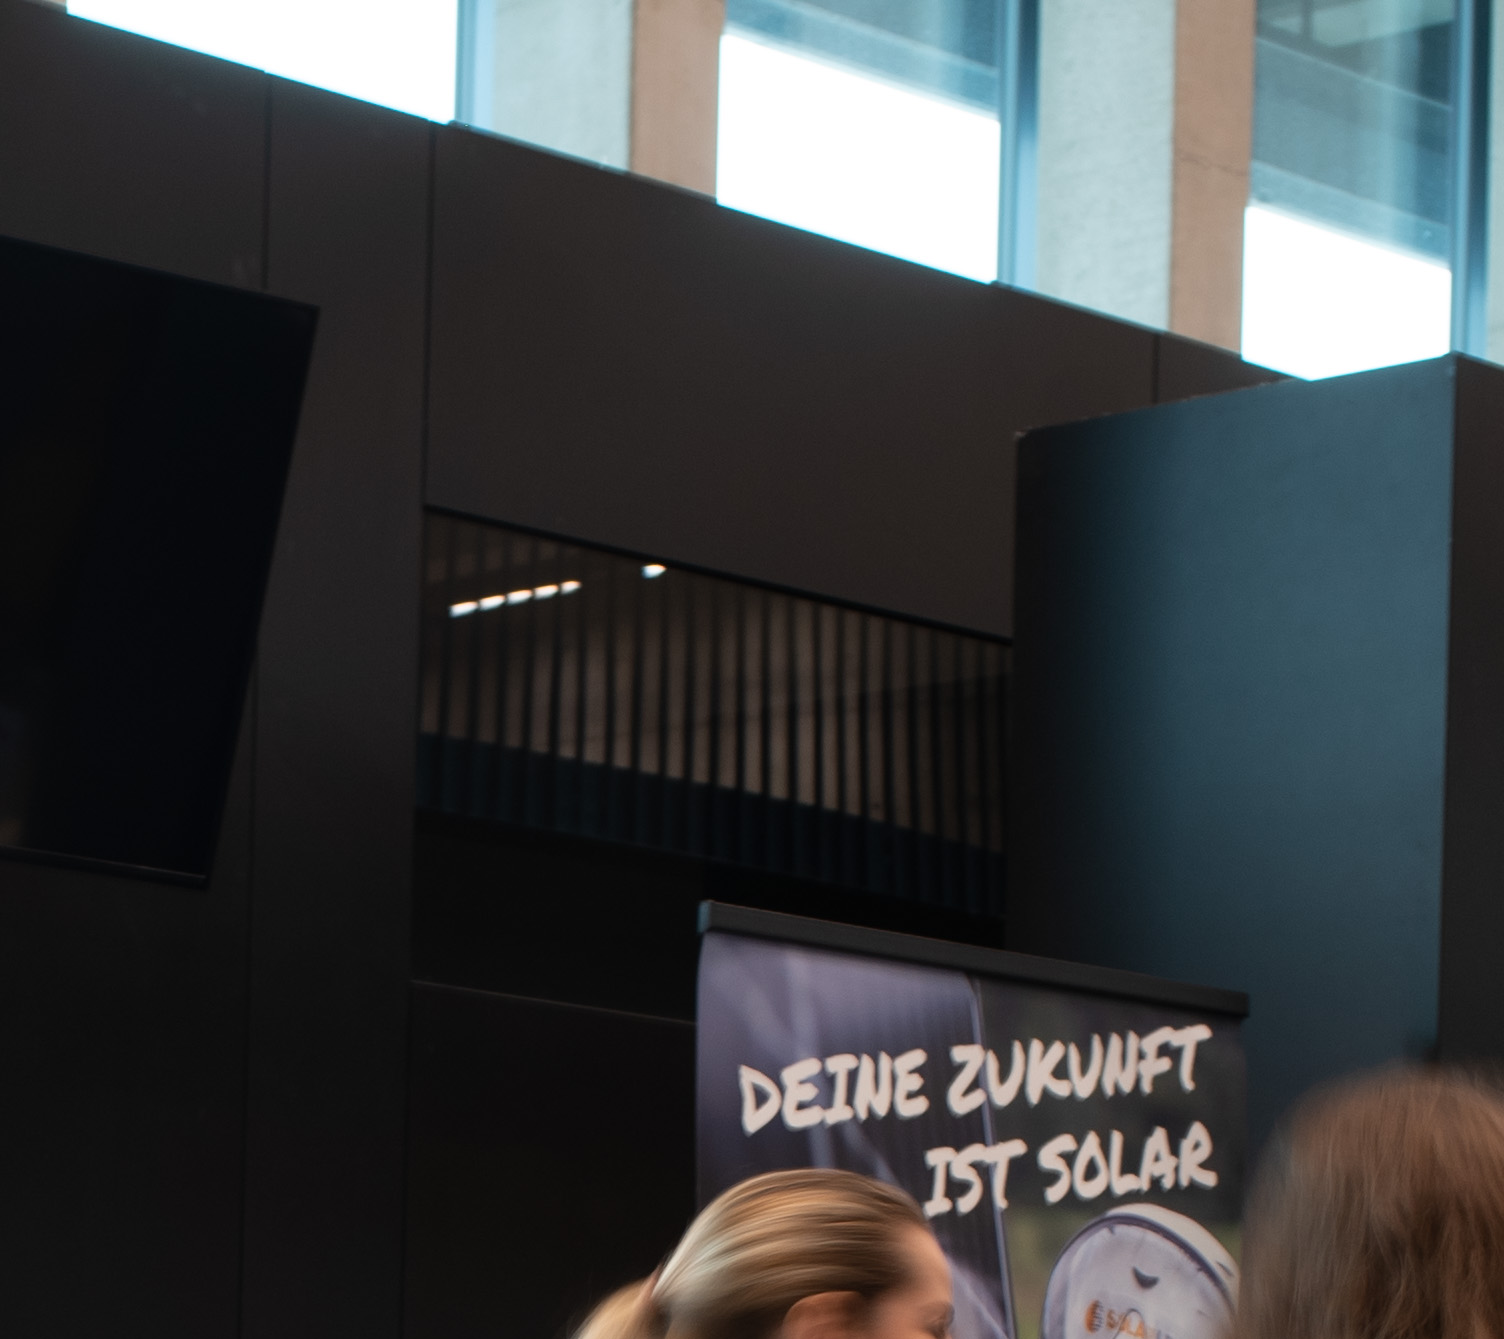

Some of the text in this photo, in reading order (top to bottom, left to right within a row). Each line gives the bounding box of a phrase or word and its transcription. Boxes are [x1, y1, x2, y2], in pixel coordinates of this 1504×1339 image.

[739, 1025, 1212, 1136] DEINE ZUKUNFT
[924, 1122, 1218, 1217] IST SOLAR
